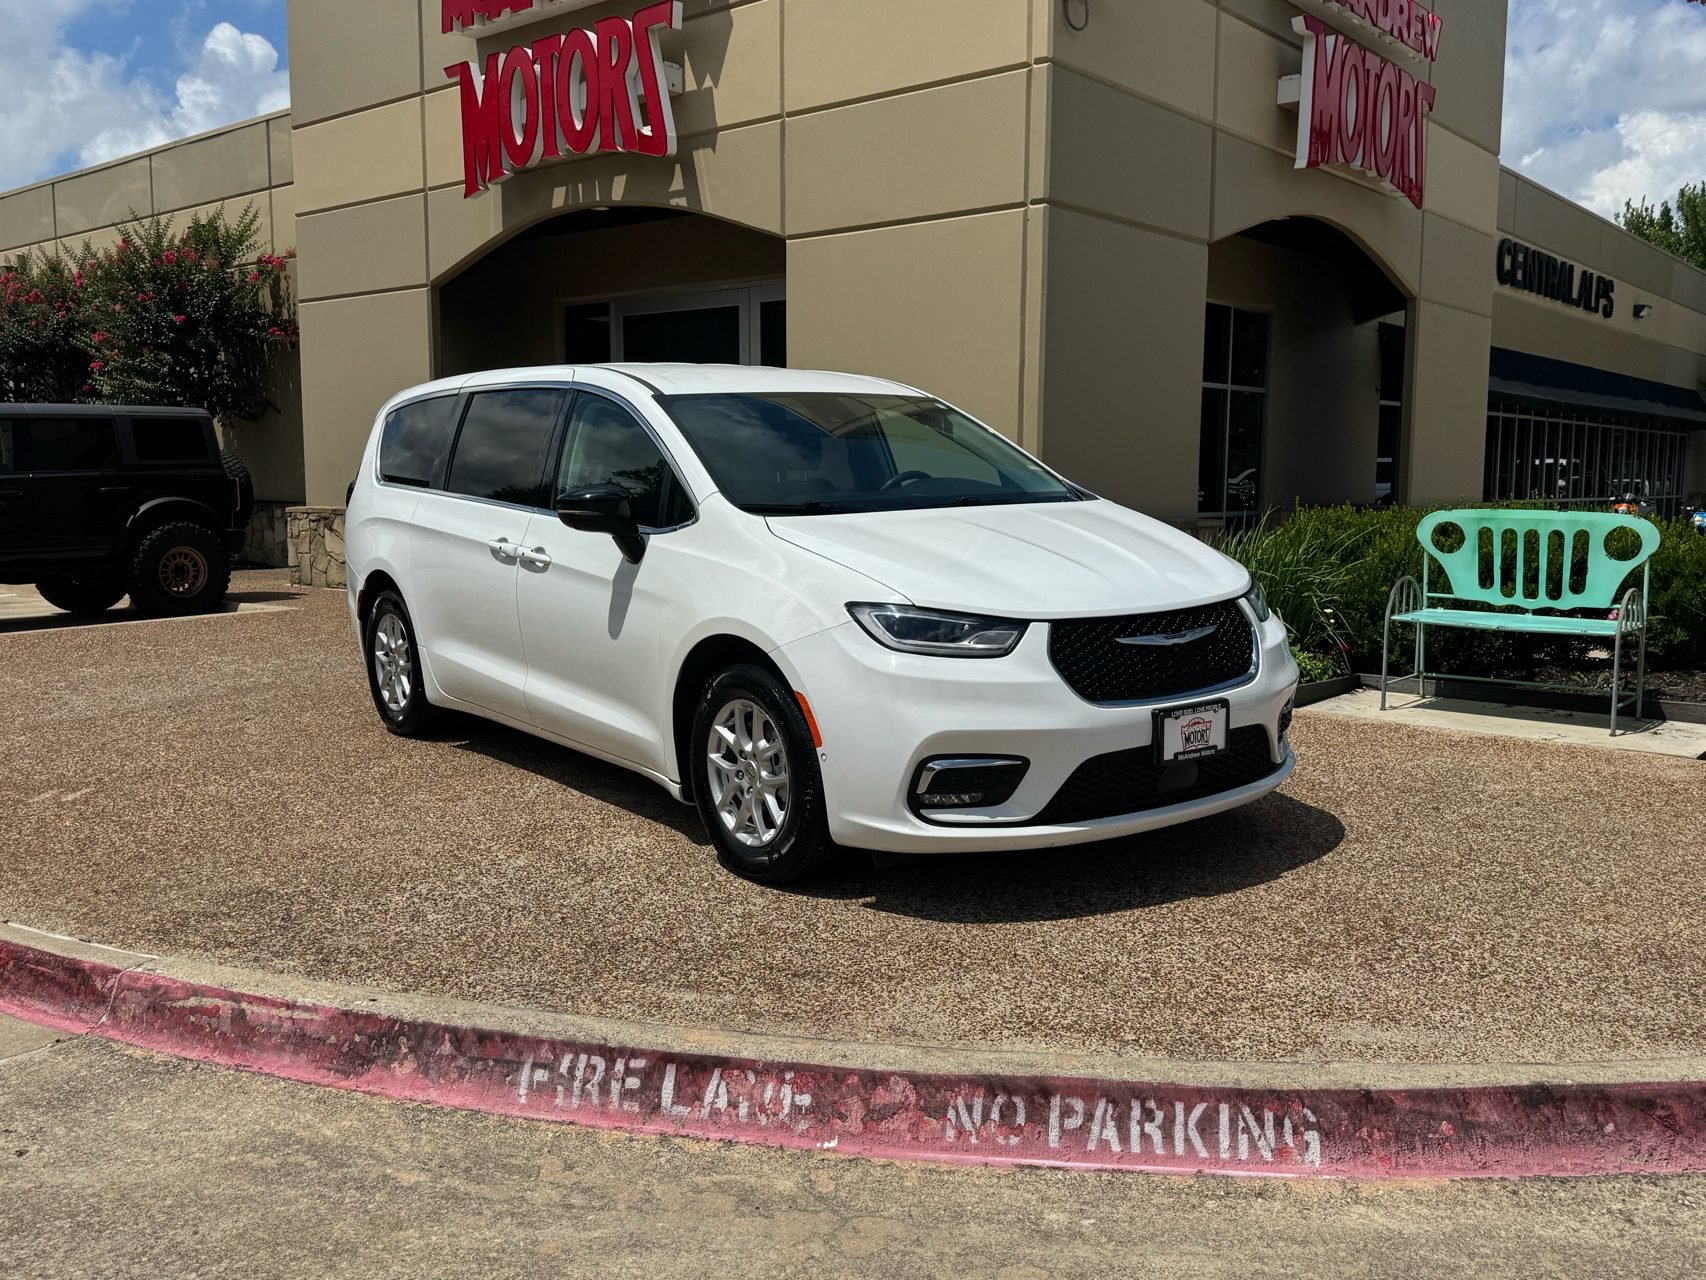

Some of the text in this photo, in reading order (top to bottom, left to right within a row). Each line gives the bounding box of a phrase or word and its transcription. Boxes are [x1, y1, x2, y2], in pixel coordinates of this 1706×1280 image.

[443, 0, 676, 199] MOTORS
[1303, 13, 1437, 210] MOTORS
[1497, 238, 1581, 308] CENTRAL
[1183, 728, 1209, 748] MOTORS
[517, 1052, 650, 1114] FIRE
[945, 1090, 1026, 1145] NO
[1047, 1093, 1322, 1168] PARKING
